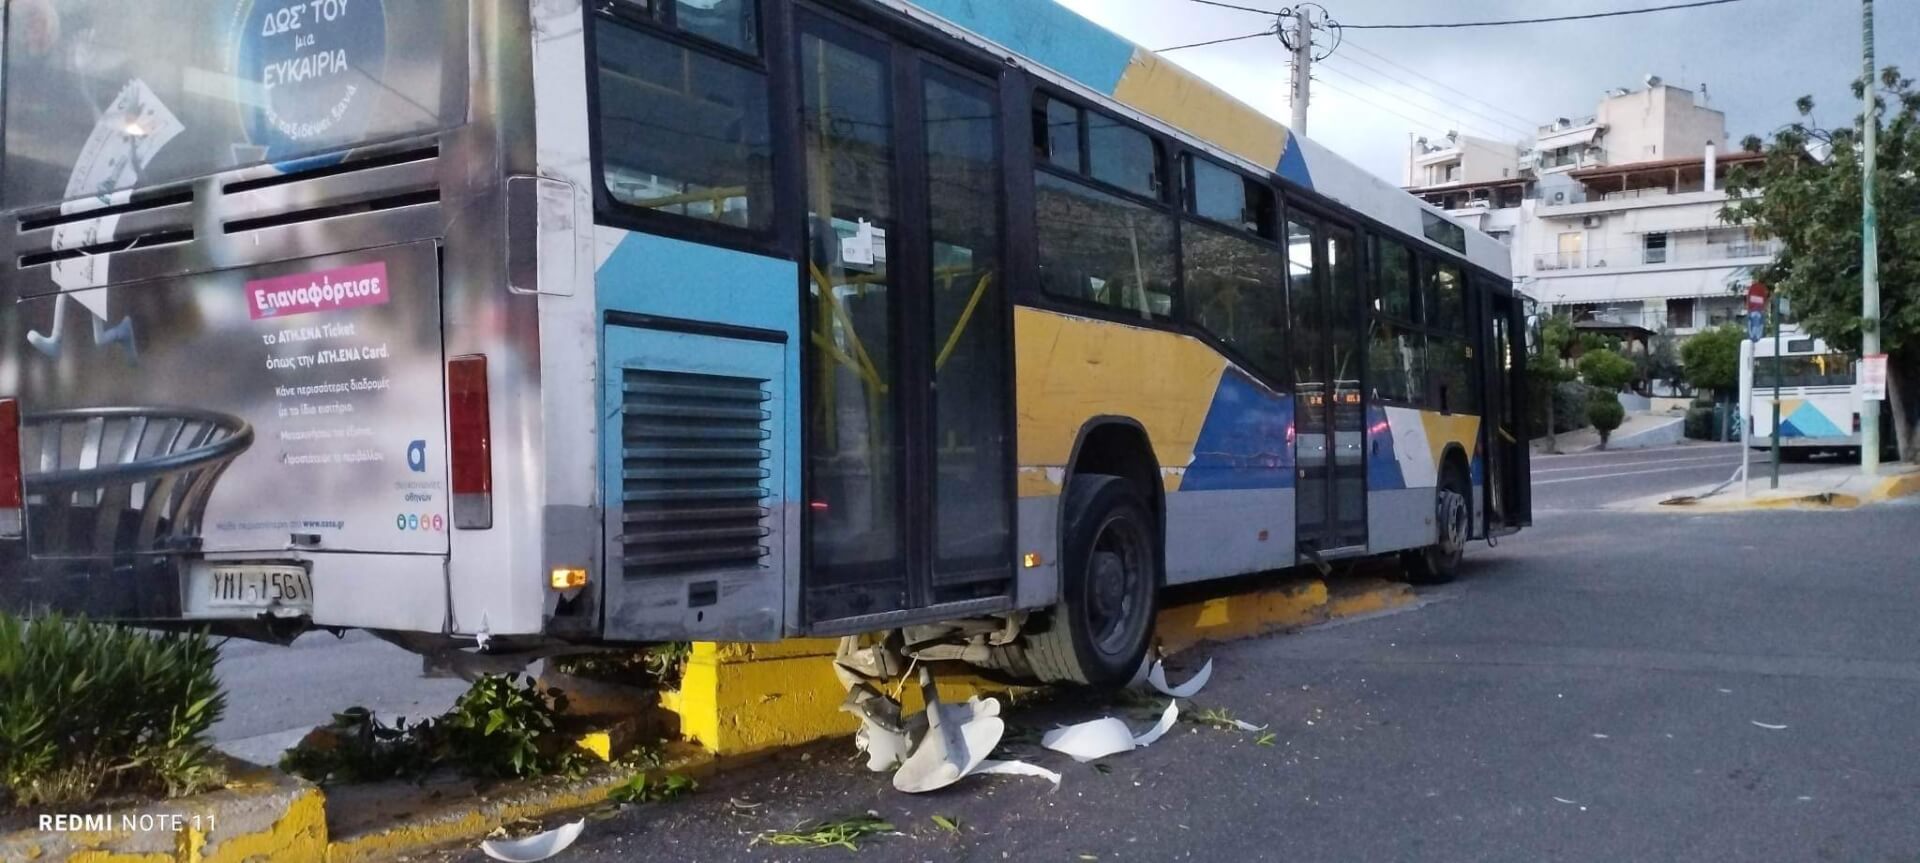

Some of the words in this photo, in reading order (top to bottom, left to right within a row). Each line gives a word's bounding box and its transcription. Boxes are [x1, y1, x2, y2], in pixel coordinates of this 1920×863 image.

[311, 0, 349, 23] ΤΟΥ
[295, 34, 315, 51] μια
[263, 48, 348, 90] ΕΥΚΑΙΡΙΑ
[254, 276, 381, 311] Επαναφόρτισε
[263, 334, 276, 345] το
[322, 322, 355, 338] Ticket
[266, 353, 296, 370] όπως
[297, 354, 314, 369] την
[361, 343, 390, 359] Card.
[275, 384, 295, 397] Κάνε
[297, 380, 349, 396] περισσότερες
[350, 377, 390, 391] διαδρομές
